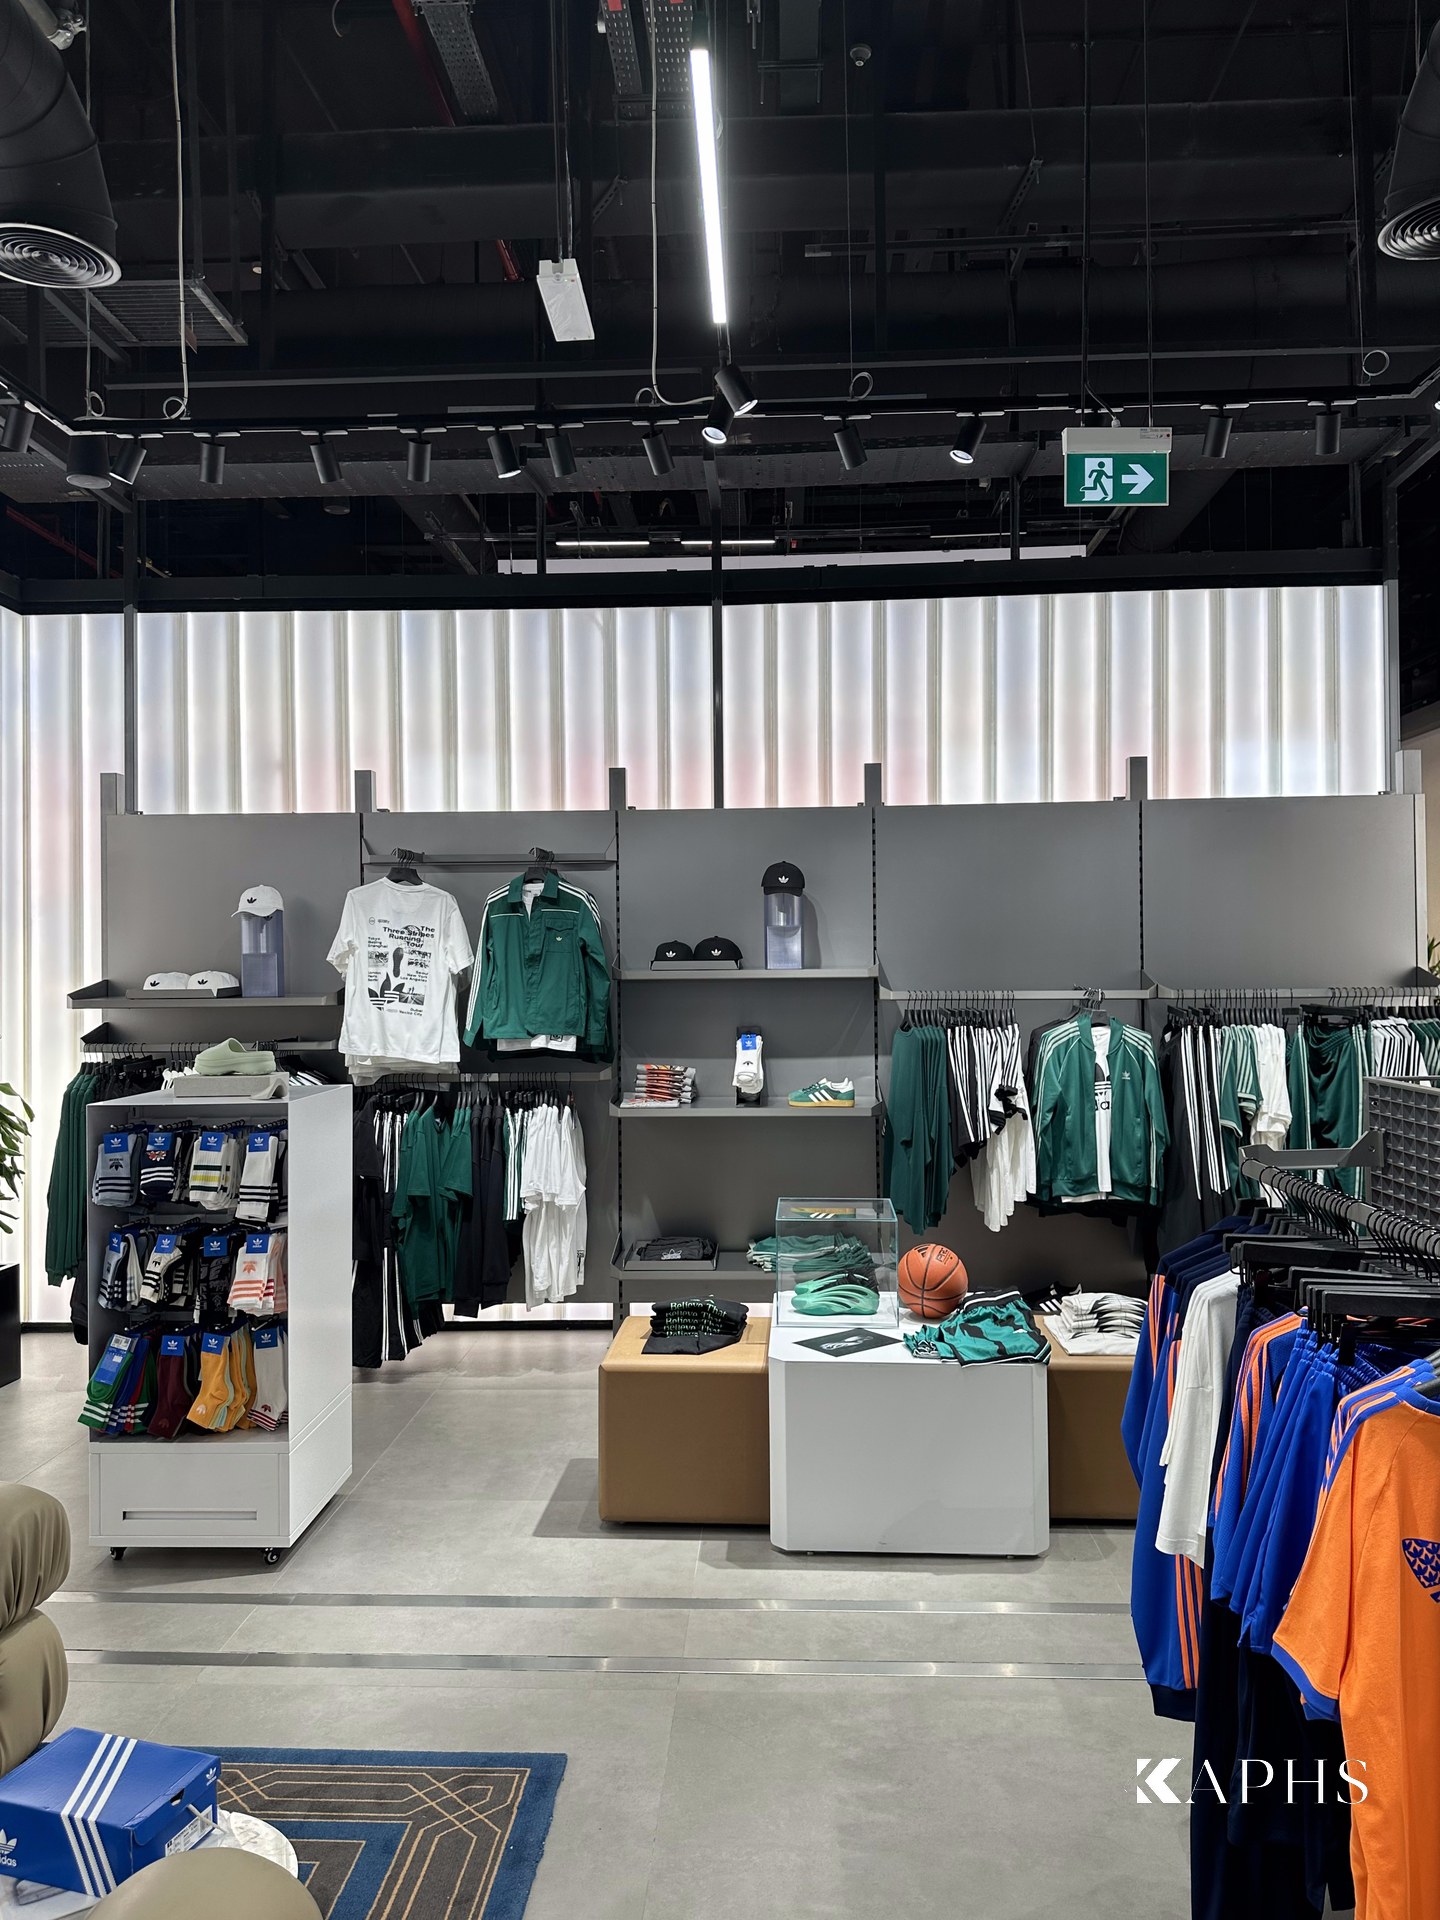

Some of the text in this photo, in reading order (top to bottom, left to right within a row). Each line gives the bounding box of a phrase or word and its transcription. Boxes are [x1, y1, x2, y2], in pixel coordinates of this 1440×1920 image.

[383, 926, 434, 938] Three Stripes
[670, 1302, 727, 1317] Believe That
